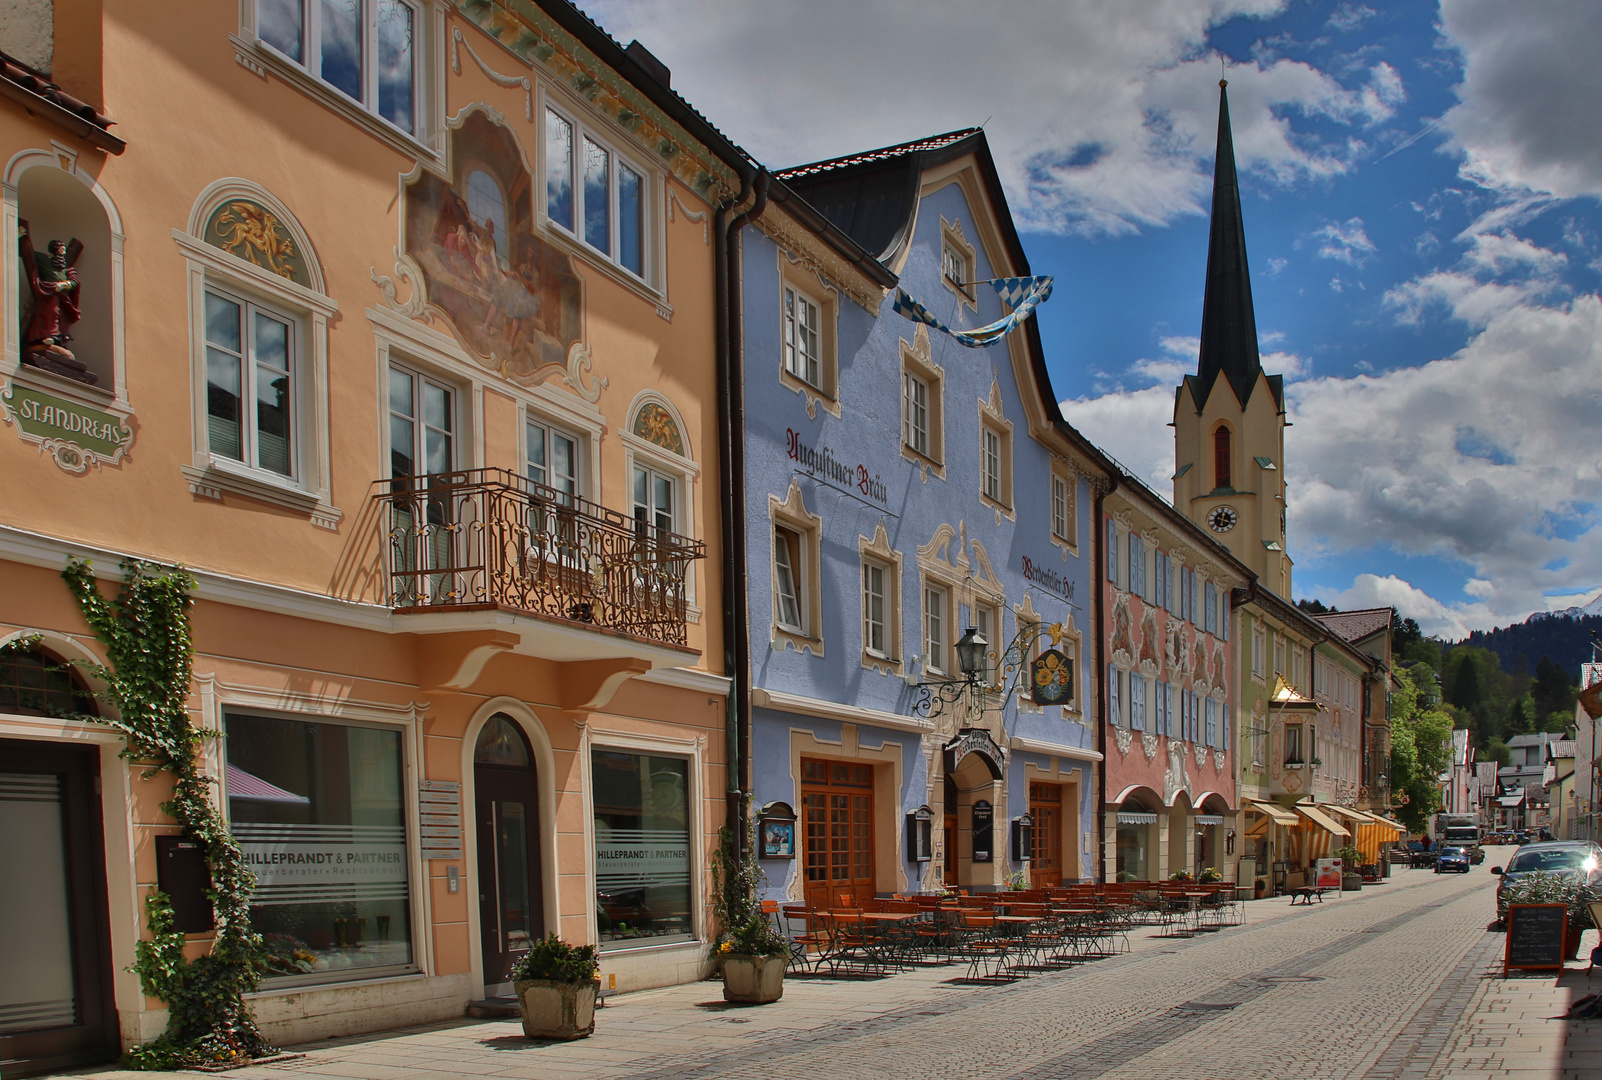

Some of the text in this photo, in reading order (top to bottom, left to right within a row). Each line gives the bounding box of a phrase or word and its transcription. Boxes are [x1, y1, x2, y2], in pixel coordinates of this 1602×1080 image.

[62, 451, 78, 465] 60
[857, 464, 888, 504] Bräu
[337, 853, 343, 864] &
[347, 852, 401, 864] PARTNER
[597, 850, 649, 859] HILLEPRANDT
[656, 850, 687, 859] PARTNER
[254, 868, 323, 876] euerberater
